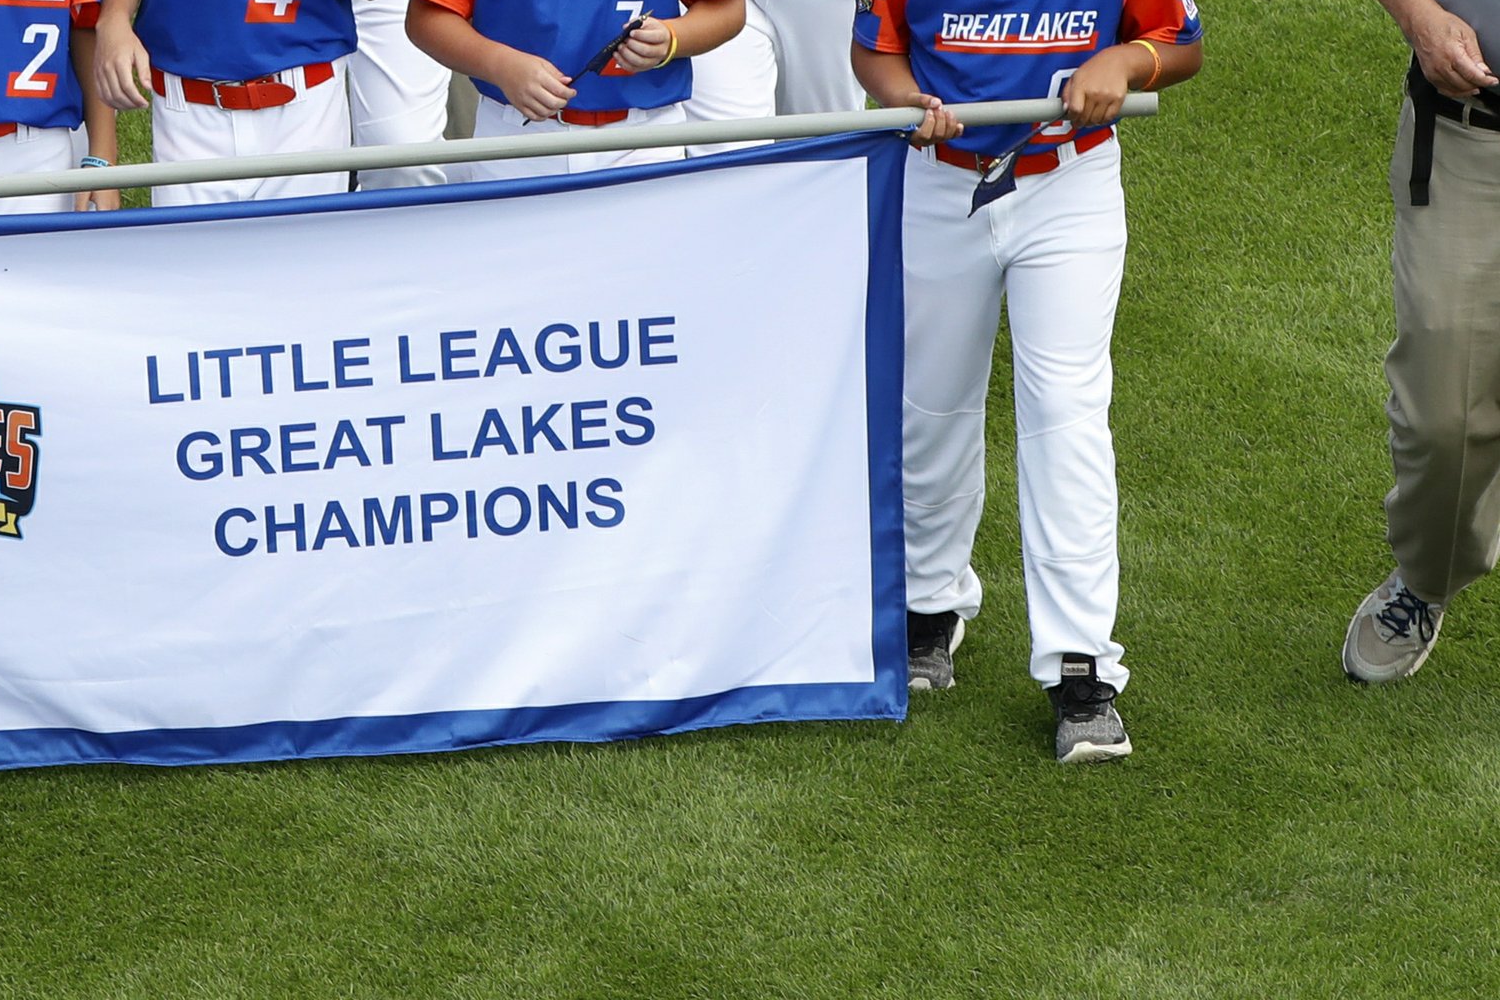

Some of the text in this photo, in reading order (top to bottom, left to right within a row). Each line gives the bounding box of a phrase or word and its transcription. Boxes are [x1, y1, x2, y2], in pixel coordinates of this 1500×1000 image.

[13, 23, 60, 91] 2
[941, 10, 1097, 42] GREAT LAKES
[146, 316, 679, 405] LITTLE LEAGUE
[176, 396, 656, 481] GREAT LAKES
[214, 477, 626, 558] CHAMPIONS
